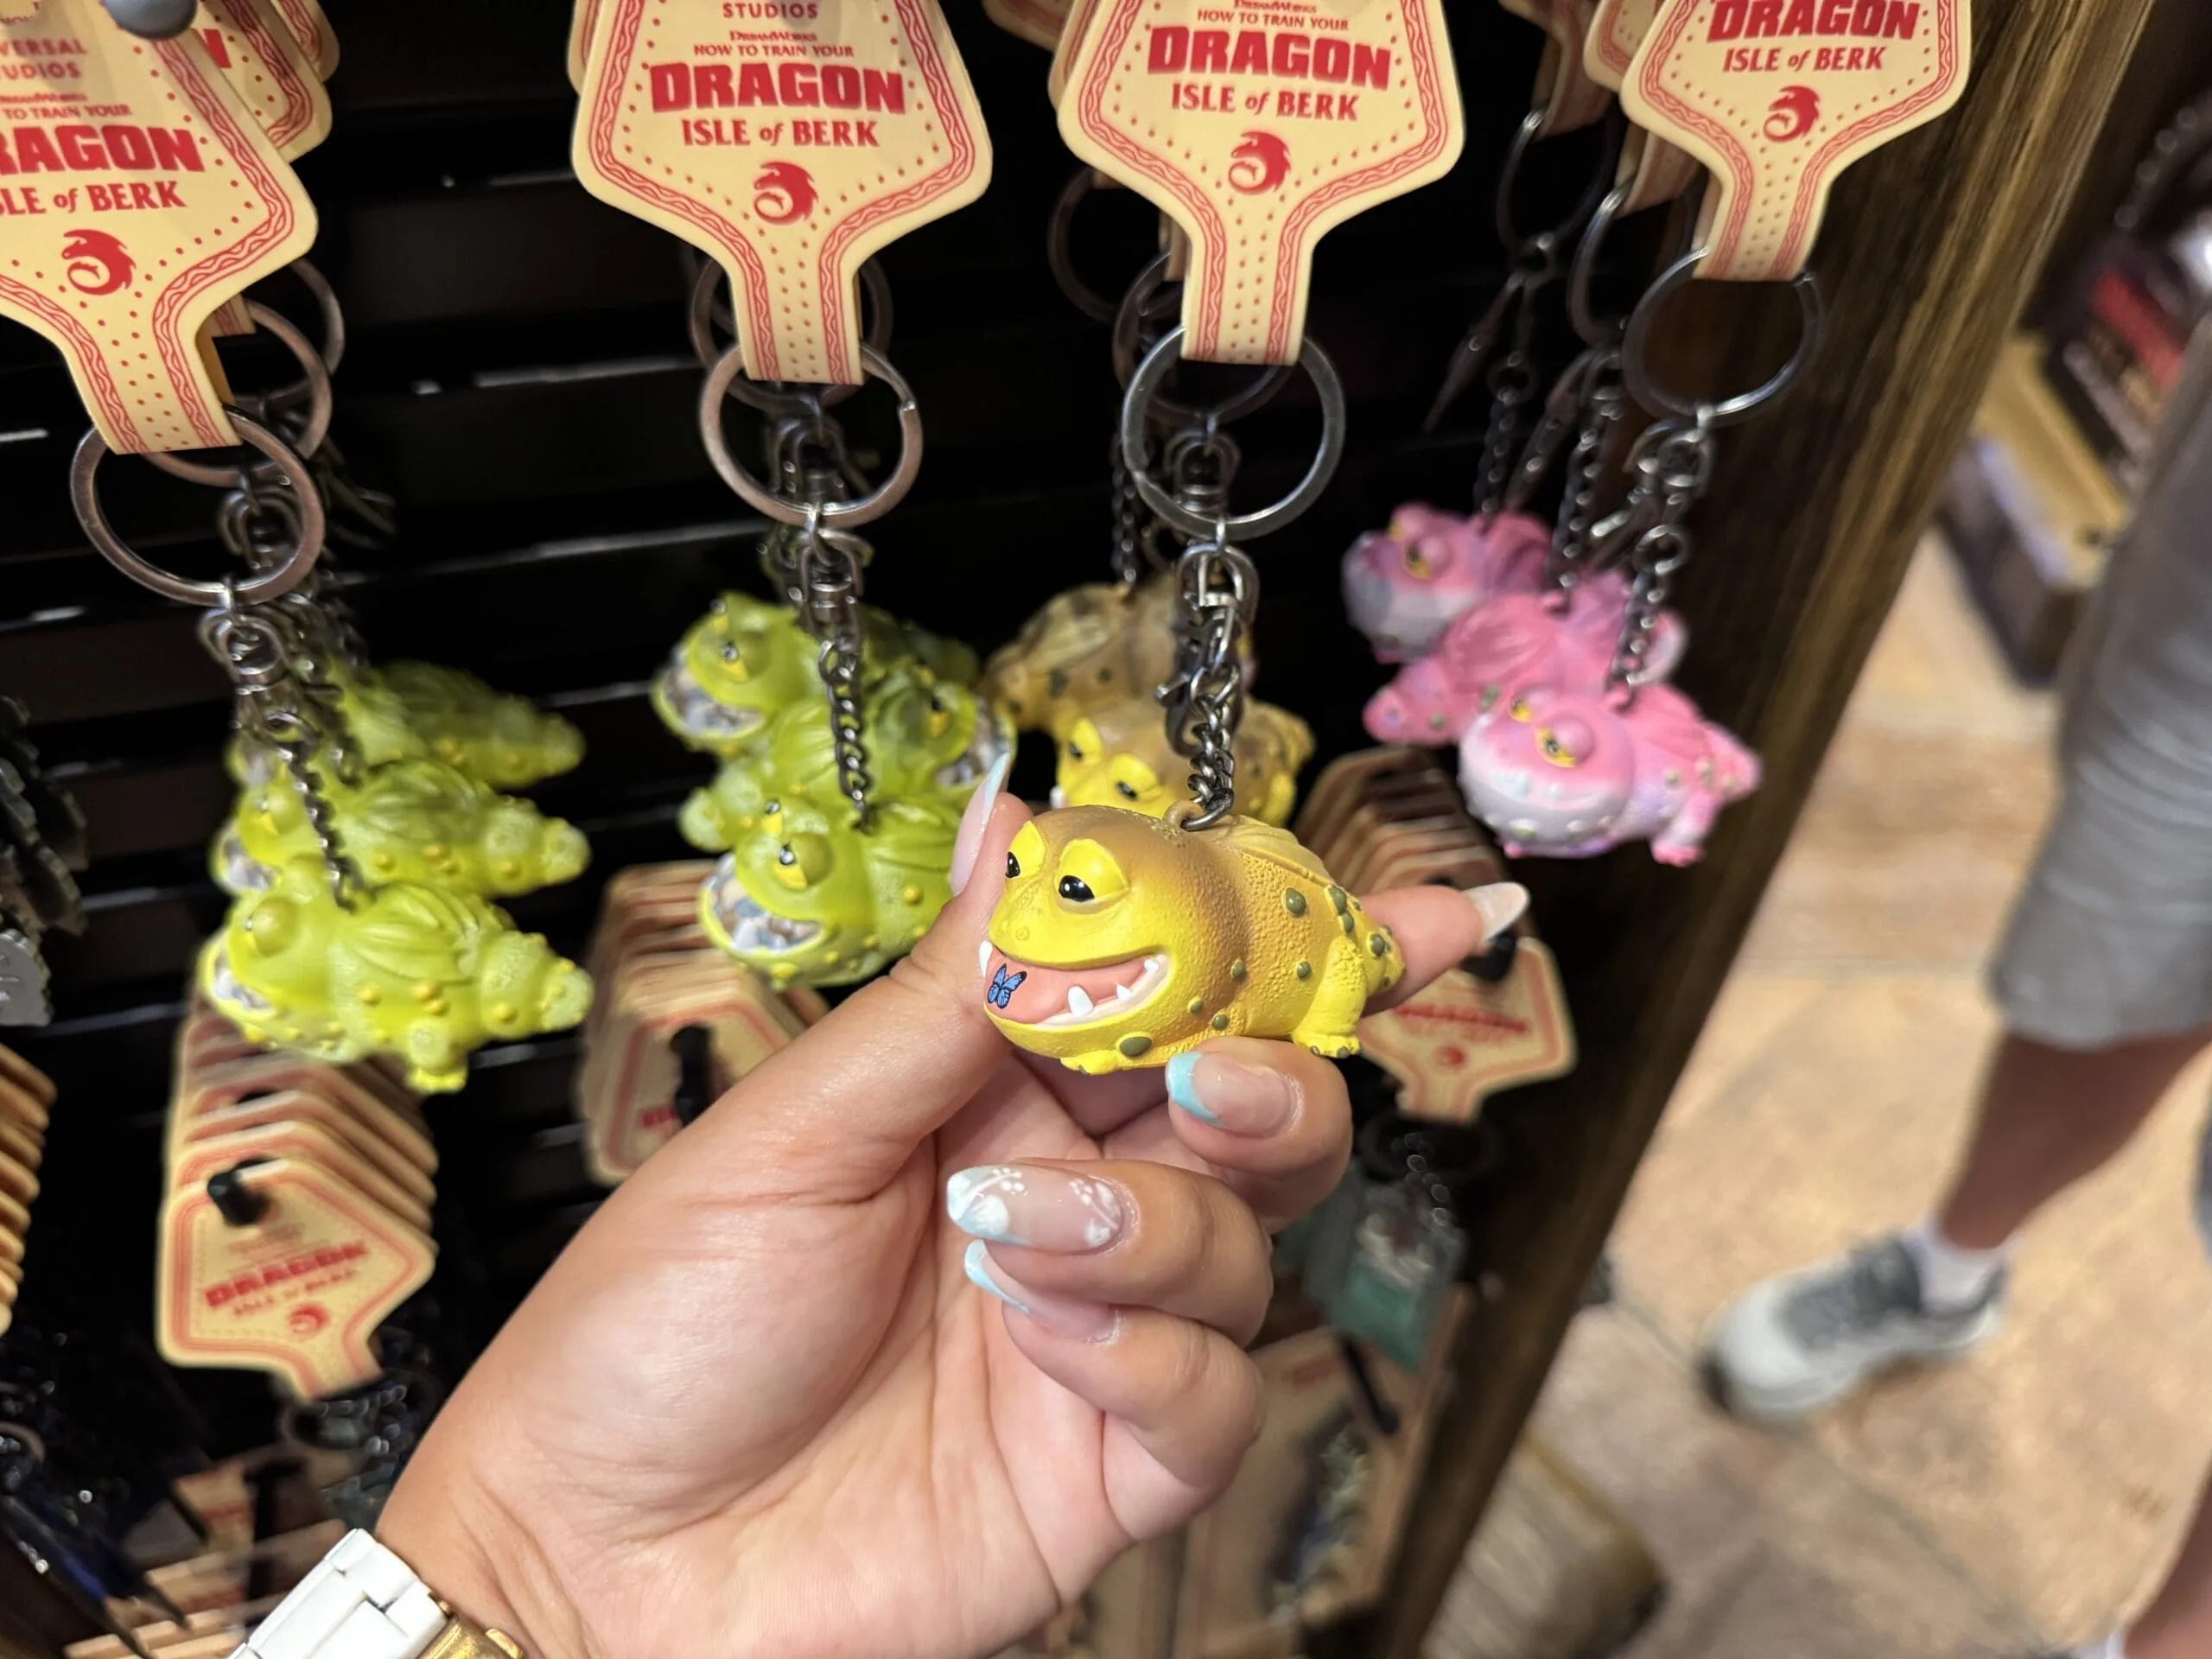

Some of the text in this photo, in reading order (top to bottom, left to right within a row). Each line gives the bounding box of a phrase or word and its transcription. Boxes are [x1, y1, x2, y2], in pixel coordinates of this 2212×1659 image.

[722, 3, 818, 19] STUDIOS
[1198, 10, 1349, 31] HOW TO TRAIN YOUR
[1707, 0, 1920, 42] DRAGON
[694, 45, 855, 57] HOW TO TRAIN YOUR
[1147, 26, 1392, 91] DRAGON
[1722, 46, 1887, 73] ISLE of BERK
[649, 62, 906, 115] DRAGON
[1172, 82, 1360, 121] ISLE of BERK
[2, 103, 133, 120] TO TRAIN YOUR
[681, 118, 880, 147] ISLE of BERK
[54, 188, 78, 213] of
[85, 180, 188, 212] BERK
